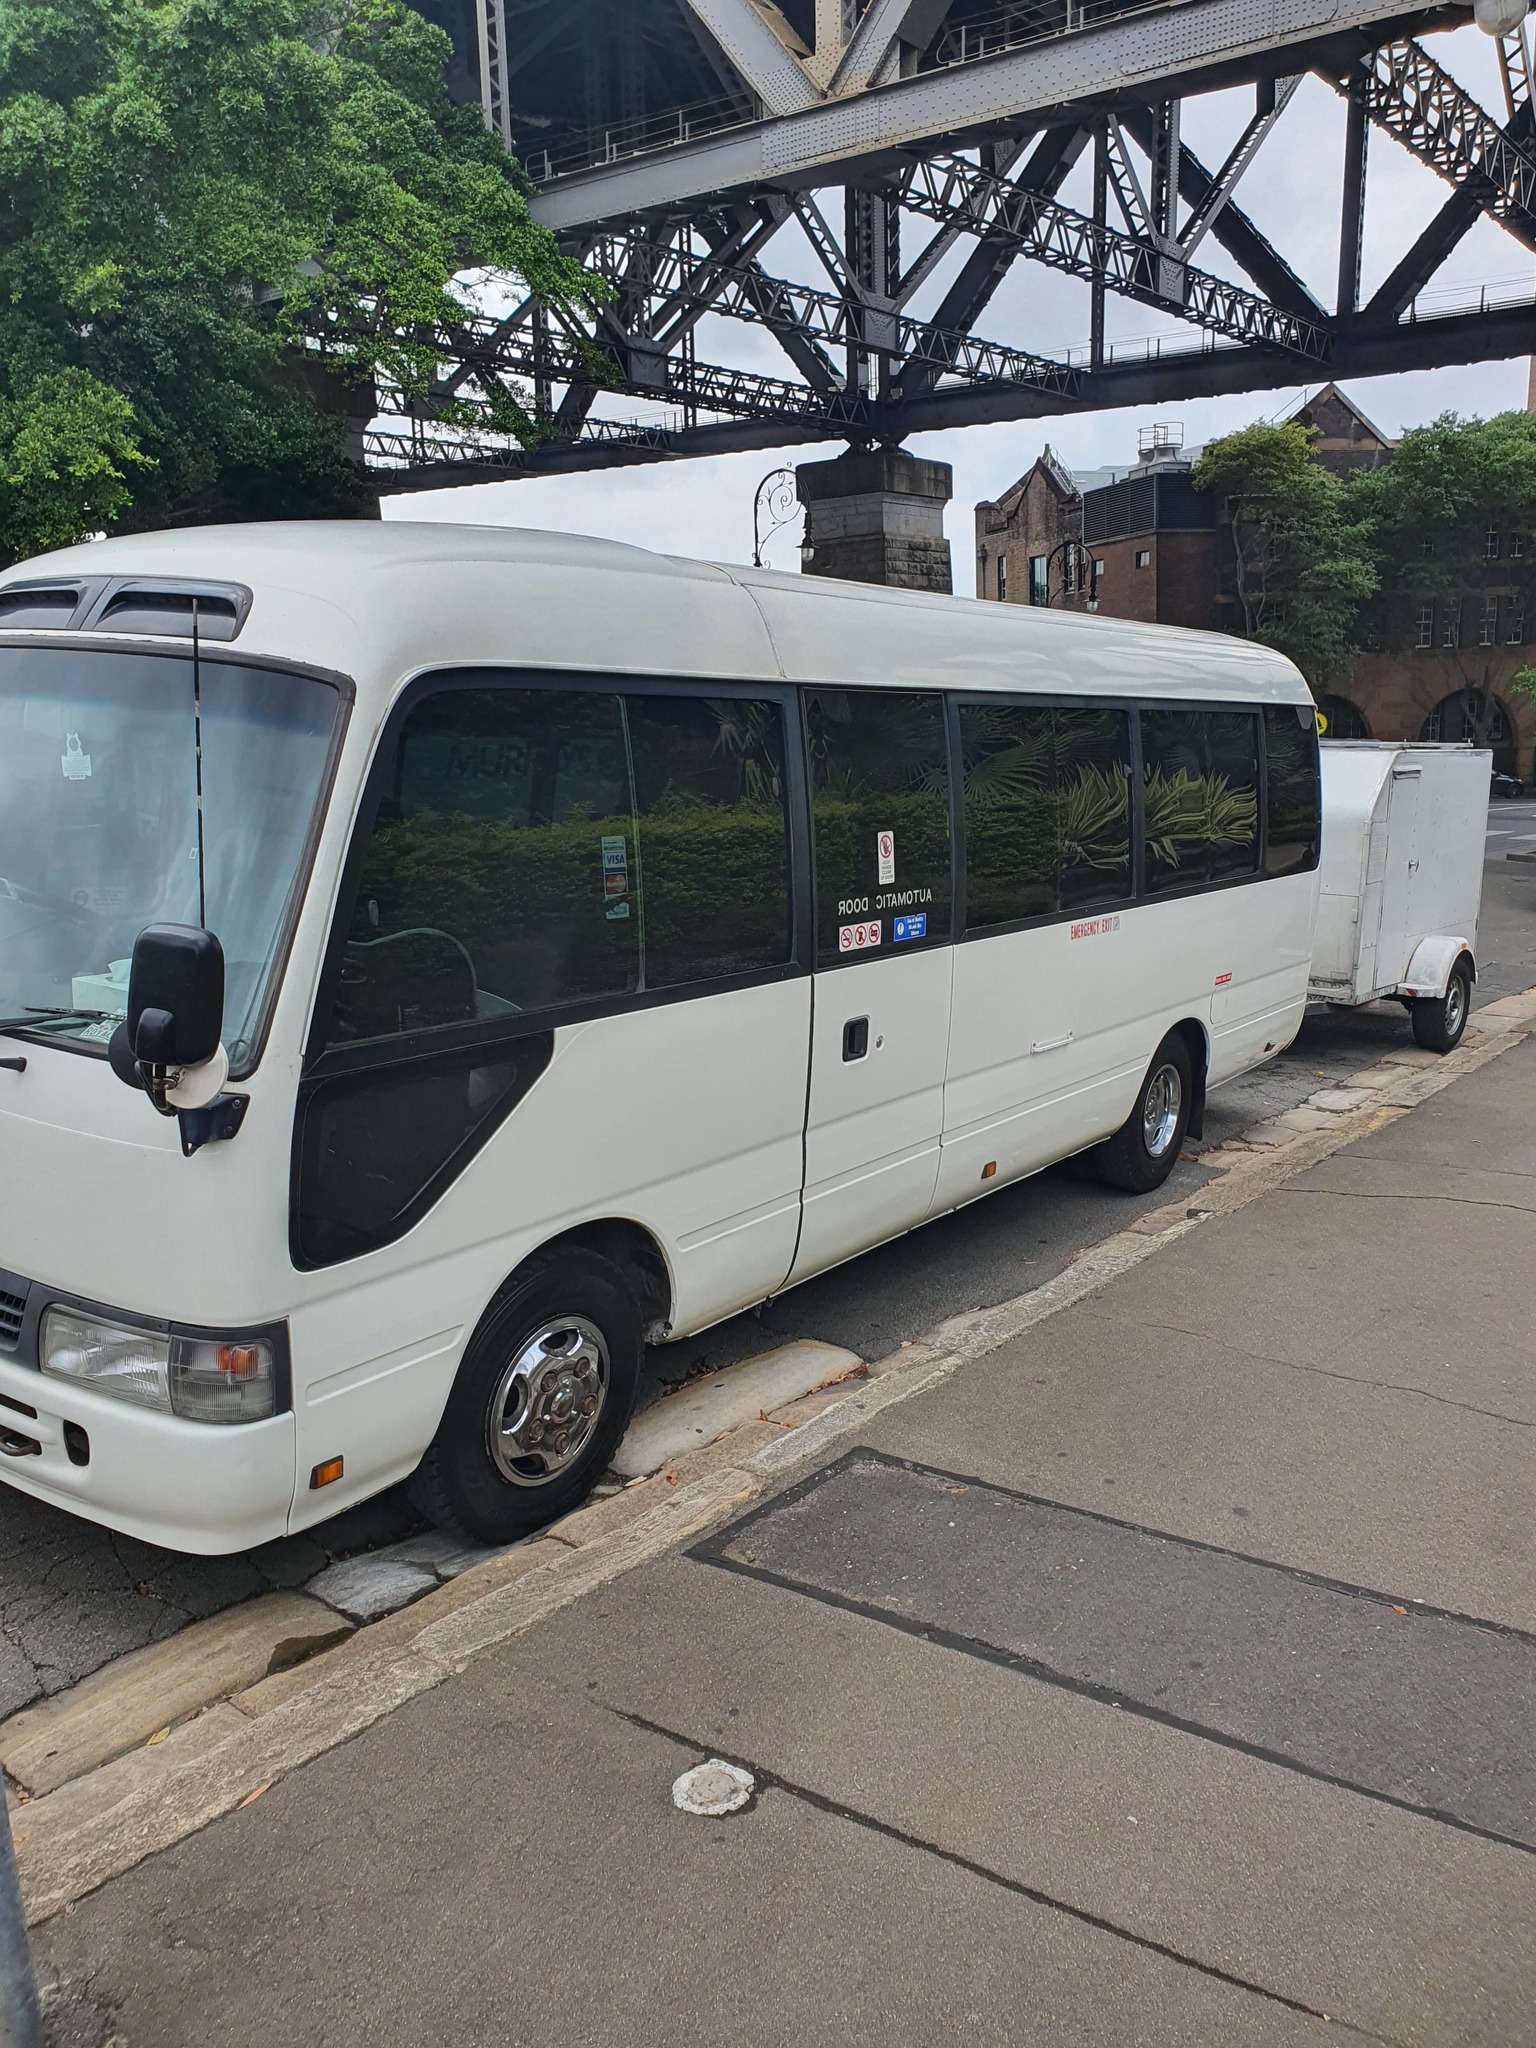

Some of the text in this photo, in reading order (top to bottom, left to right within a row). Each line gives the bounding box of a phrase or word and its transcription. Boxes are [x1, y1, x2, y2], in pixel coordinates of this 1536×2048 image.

[606, 854, 625, 865] VISA
[1071, 917, 1113, 940] EMERGENCY EXIT
